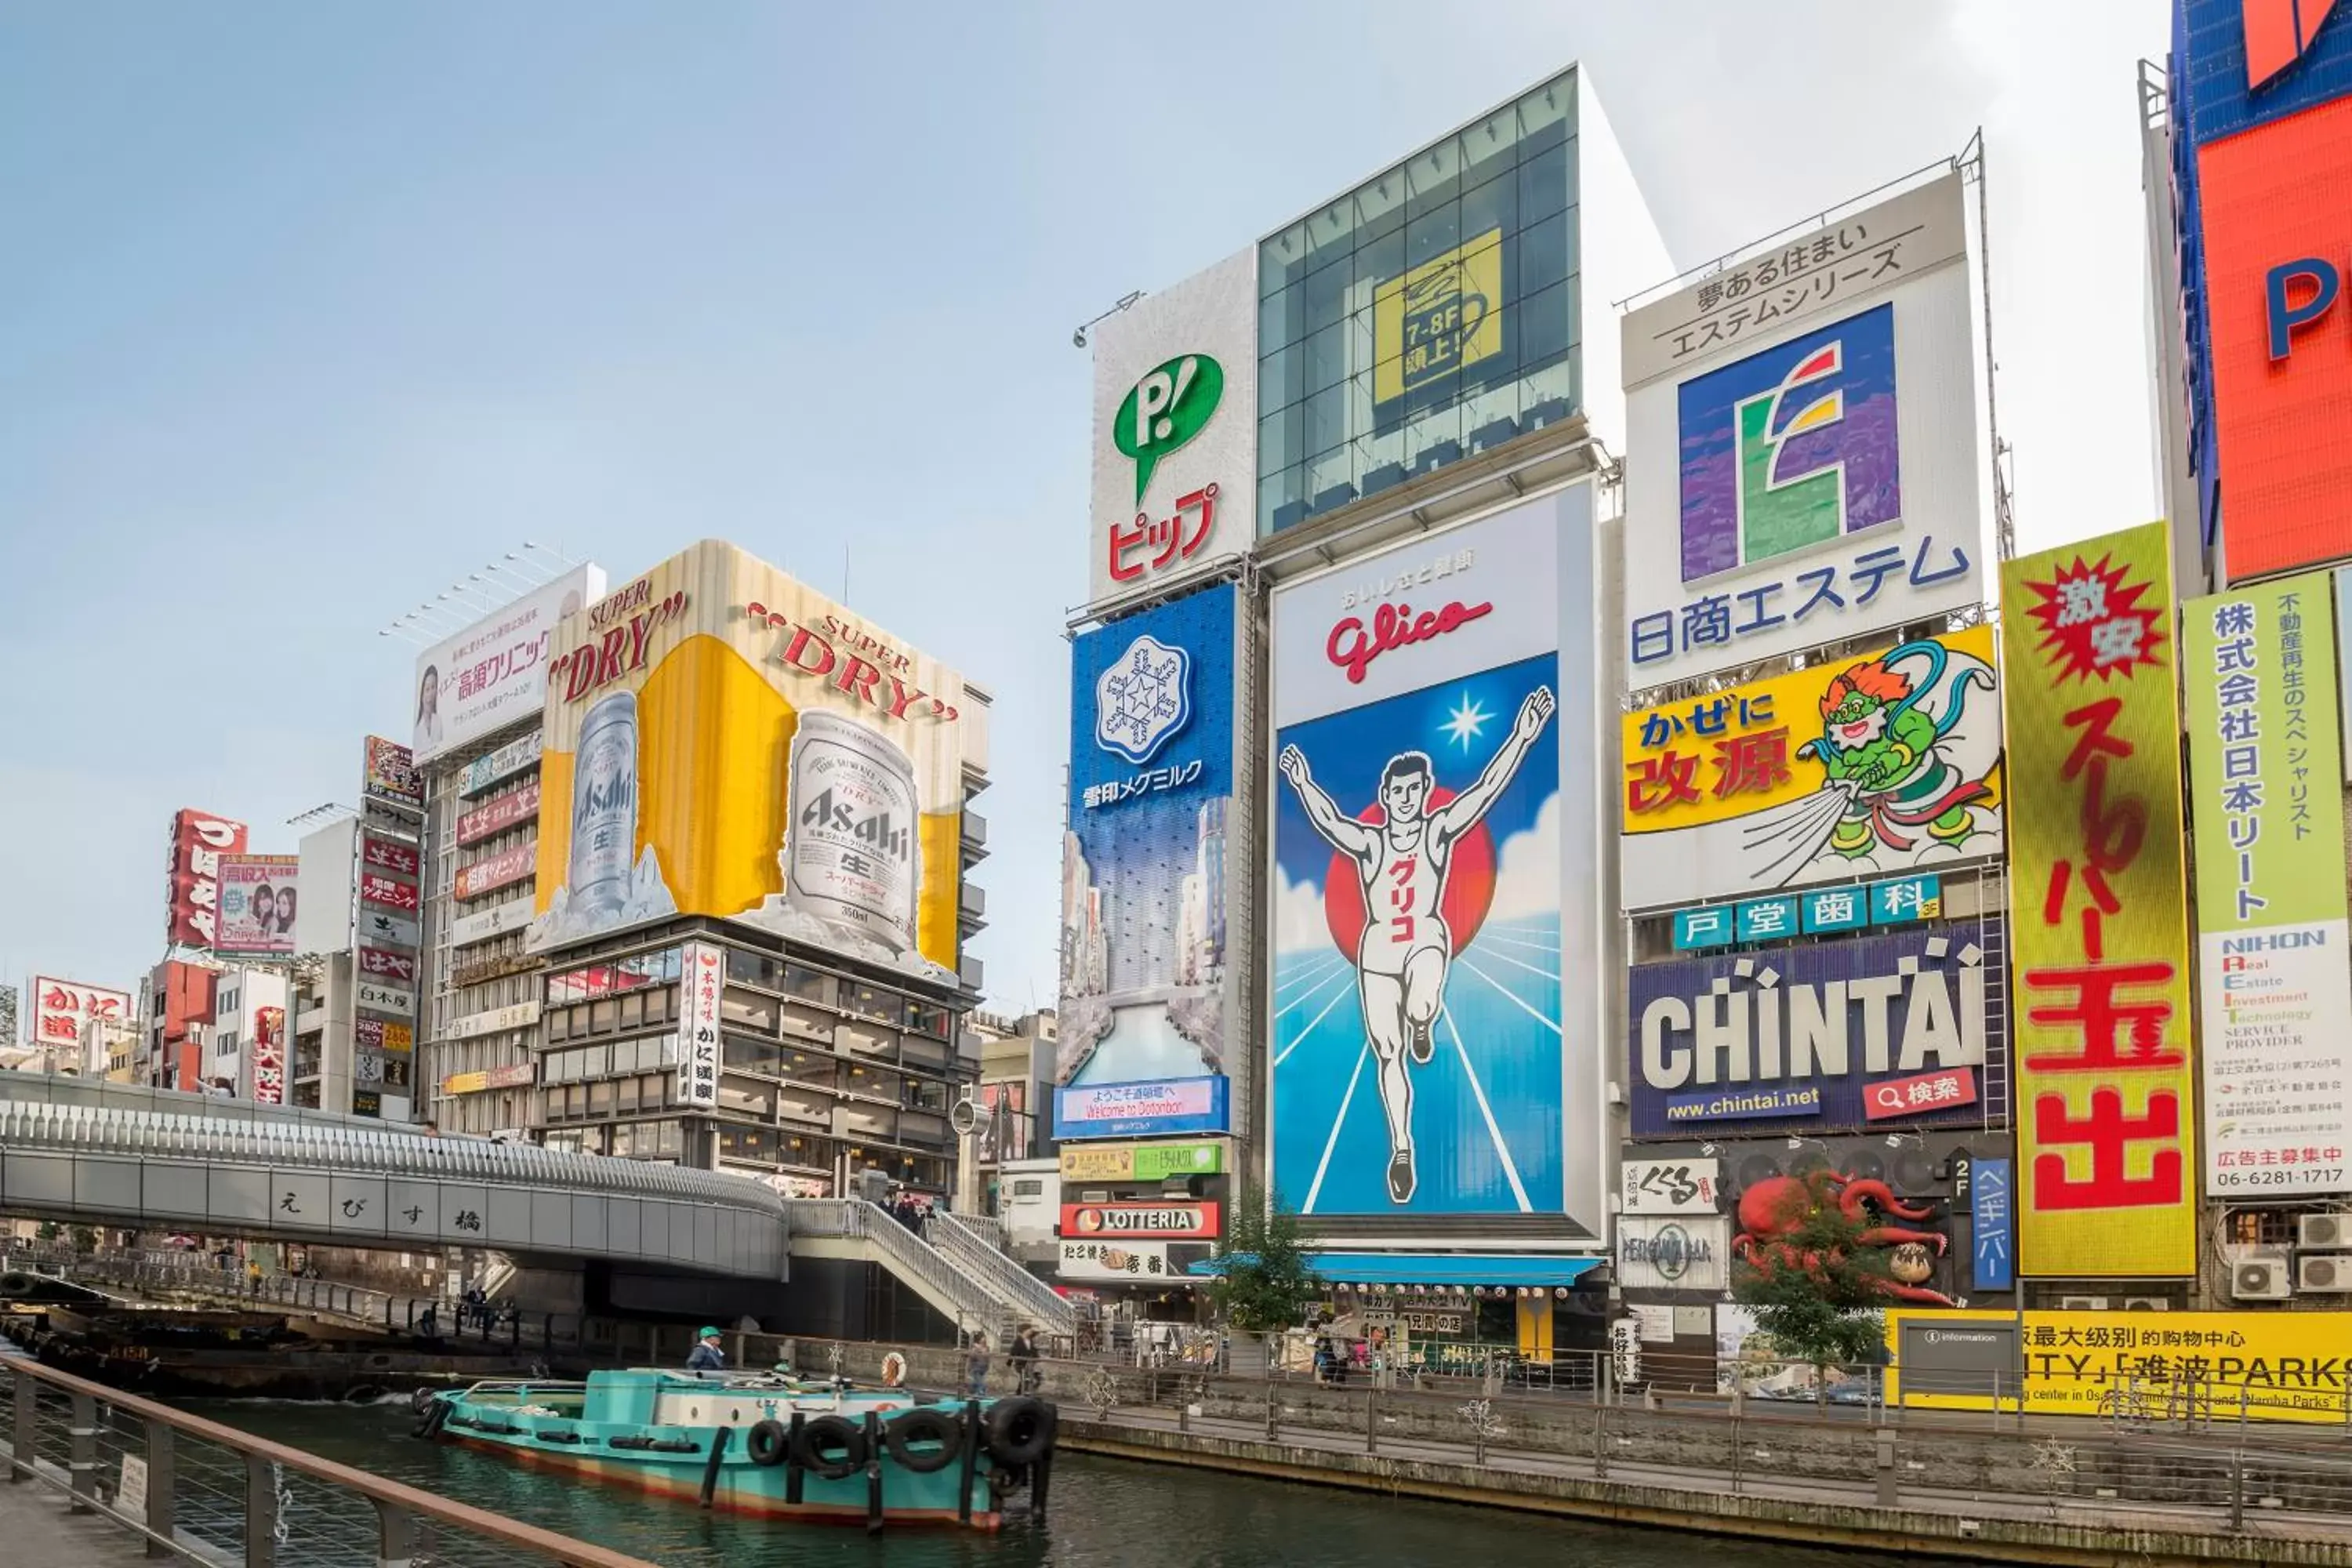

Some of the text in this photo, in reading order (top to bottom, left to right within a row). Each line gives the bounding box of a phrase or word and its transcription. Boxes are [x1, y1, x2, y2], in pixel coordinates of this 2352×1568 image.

[1697, 224, 1867, 312] 夢ある住まい
[1671, 244, 1902, 358] エステムシリーズ
[1406, 303, 1458, 345] 7-8F
[1109, 482, 1221, 583] ピップ
[1341, 550, 1475, 610] おいしさと健康
[1632, 535, 1969, 663] 日商エステム
[588, 577, 652, 630] SUPER
[2055, 573, 2144, 666] 激安
[822, 613, 912, 675] SUPER
[1639, 692, 1774, 749] かぜに
[2277, 593, 2312, 841] 不動産再生のスペシャリスト
[1625, 724, 1795, 814] 改源
[2214, 602, 2270, 920] 株式会社日本リート
[577, 766, 631, 829] Asahi
[1083, 759, 1202, 809] 雪印メグミルク
[593, 829, 609, 852] 生
[802, 787, 908, 862] Asahi
[840, 852, 871, 880] 生
[1388, 852, 1418, 943] グリコ
[1686, 880, 1923, 942] 戸堂歯科
[1922, 902, 1939, 917] 3F
[2223, 929, 2325, 954] NIHON
[2223, 956, 2269, 972] Real
[2223, 974, 2284, 990] Estate
[44, 985, 120, 1022] かに
[361, 986, 409, 1008] 白木屋
[699, 970, 715, 1023] 本場の味
[2222, 1008, 2313, 1025] Technology
[2224, 992, 2309, 1007] Investment
[2224, 1025, 2289, 1038] SERVICE
[2226, 1036, 2303, 1050] PROVIDER
[695, 1026, 715, 1100] かに道楽
[1087, 1104, 1124, 1119] Welcome
[1127, 1103, 1136, 1116] to
[1092, 1086, 1176, 1102] ようこそ道頓堀へ
[1907, 1078, 1961, 1105] 検索
[2218, 1146, 2343, 1167] 広告主募集中
[1639, 1166, 1699, 1206] くくる
[1956, 1160, 1969, 1197] 2F
[2218, 1169, 2343, 1186] 06-6281-1717
[280, 1192, 481, 1232] えびす橋
[1105, 1210, 1190, 1229] LOTTERIA
[1978, 1167, 2006, 1277] ペンギンバー
[1065, 1244, 1109, 1260] たこ焼き
[1942, 1334, 1997, 1342] information
[2033, 1390, 2068, 1402] center
[2072, 1389, 2082, 1401] in
